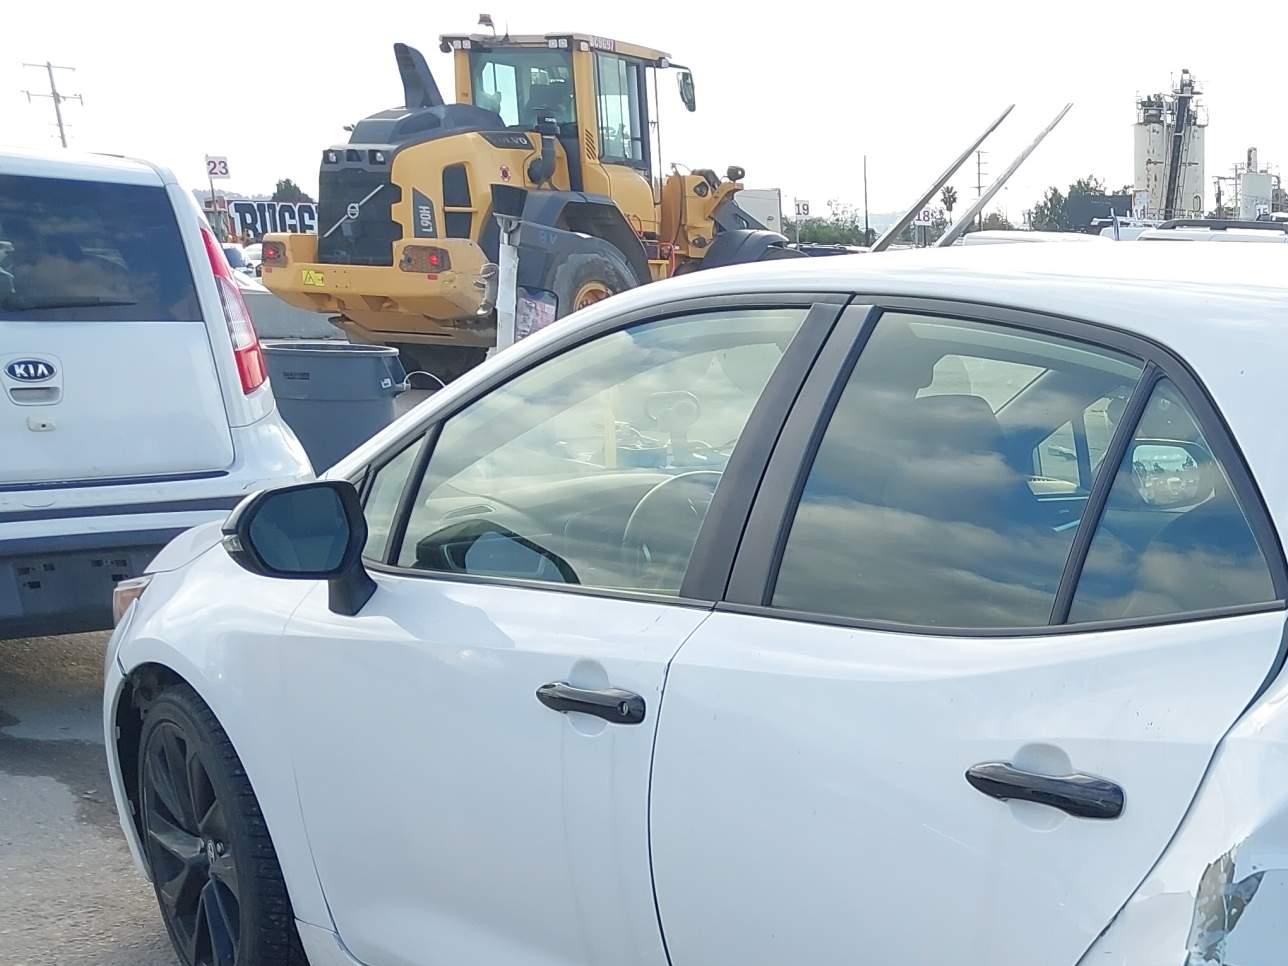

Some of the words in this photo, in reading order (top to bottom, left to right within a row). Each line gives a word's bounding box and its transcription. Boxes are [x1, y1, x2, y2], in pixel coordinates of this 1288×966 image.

[207, 160, 229, 176] 23
[795, 203, 810, 216] 19
[418, 205, 433, 232] L90H
[13, 363, 49, 377] KIA
